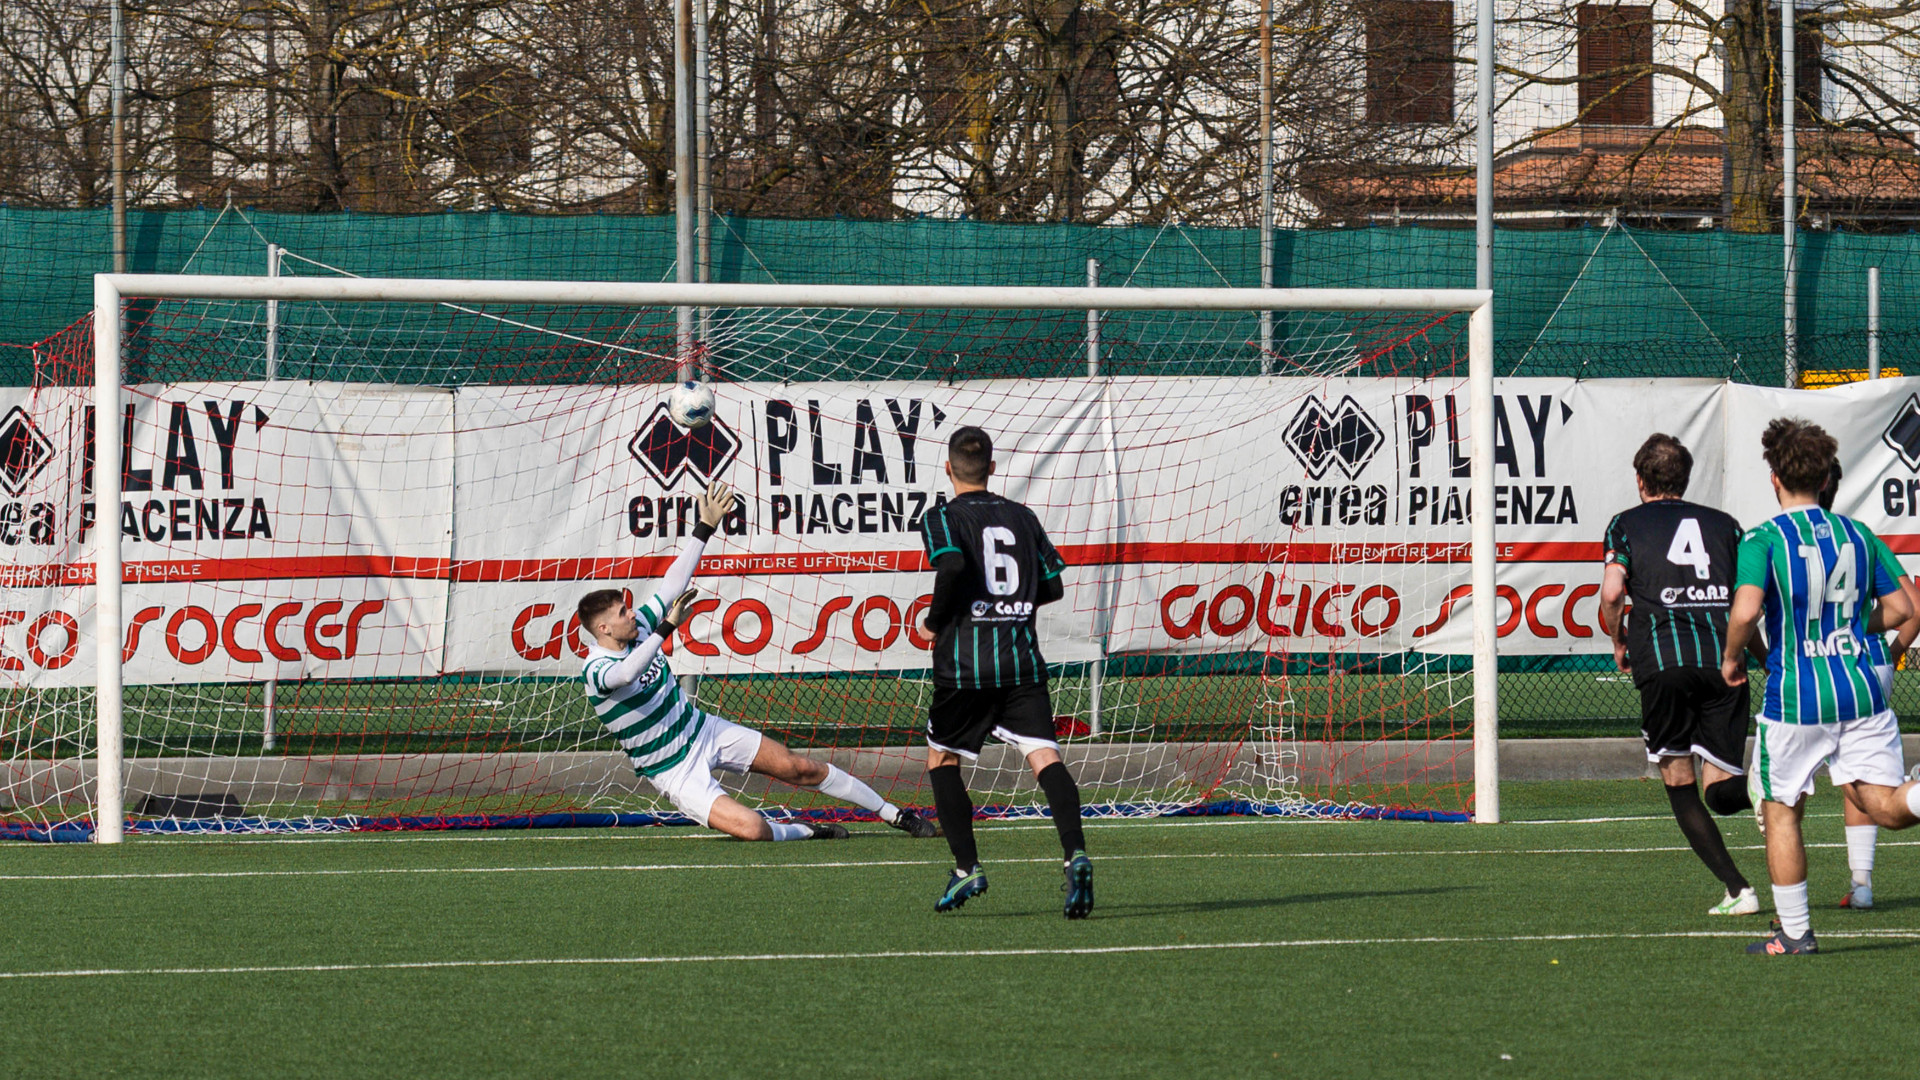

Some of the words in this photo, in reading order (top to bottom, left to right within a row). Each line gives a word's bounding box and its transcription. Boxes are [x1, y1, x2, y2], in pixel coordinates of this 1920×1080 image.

[765, 398, 922, 486] PLAY
[1406, 395, 1552, 478] PLAY
[78, 497, 272, 544] PACENZA
[629, 493, 747, 538] erra
[1409, 485, 1578, 525] PIAENZA
[700, 557, 798, 570] FORNITORE
[803, 555, 888, 568] UFFICIALE
[982, 526, 1020, 596] 6
[1342, 546, 1429, 558] FORNITORE
[1666, 517, 1711, 580] 4
[4, 566, 97, 582] FORNITOR
[125, 563, 202, 577] FFICIALE
[1797, 542, 1860, 621] 14
